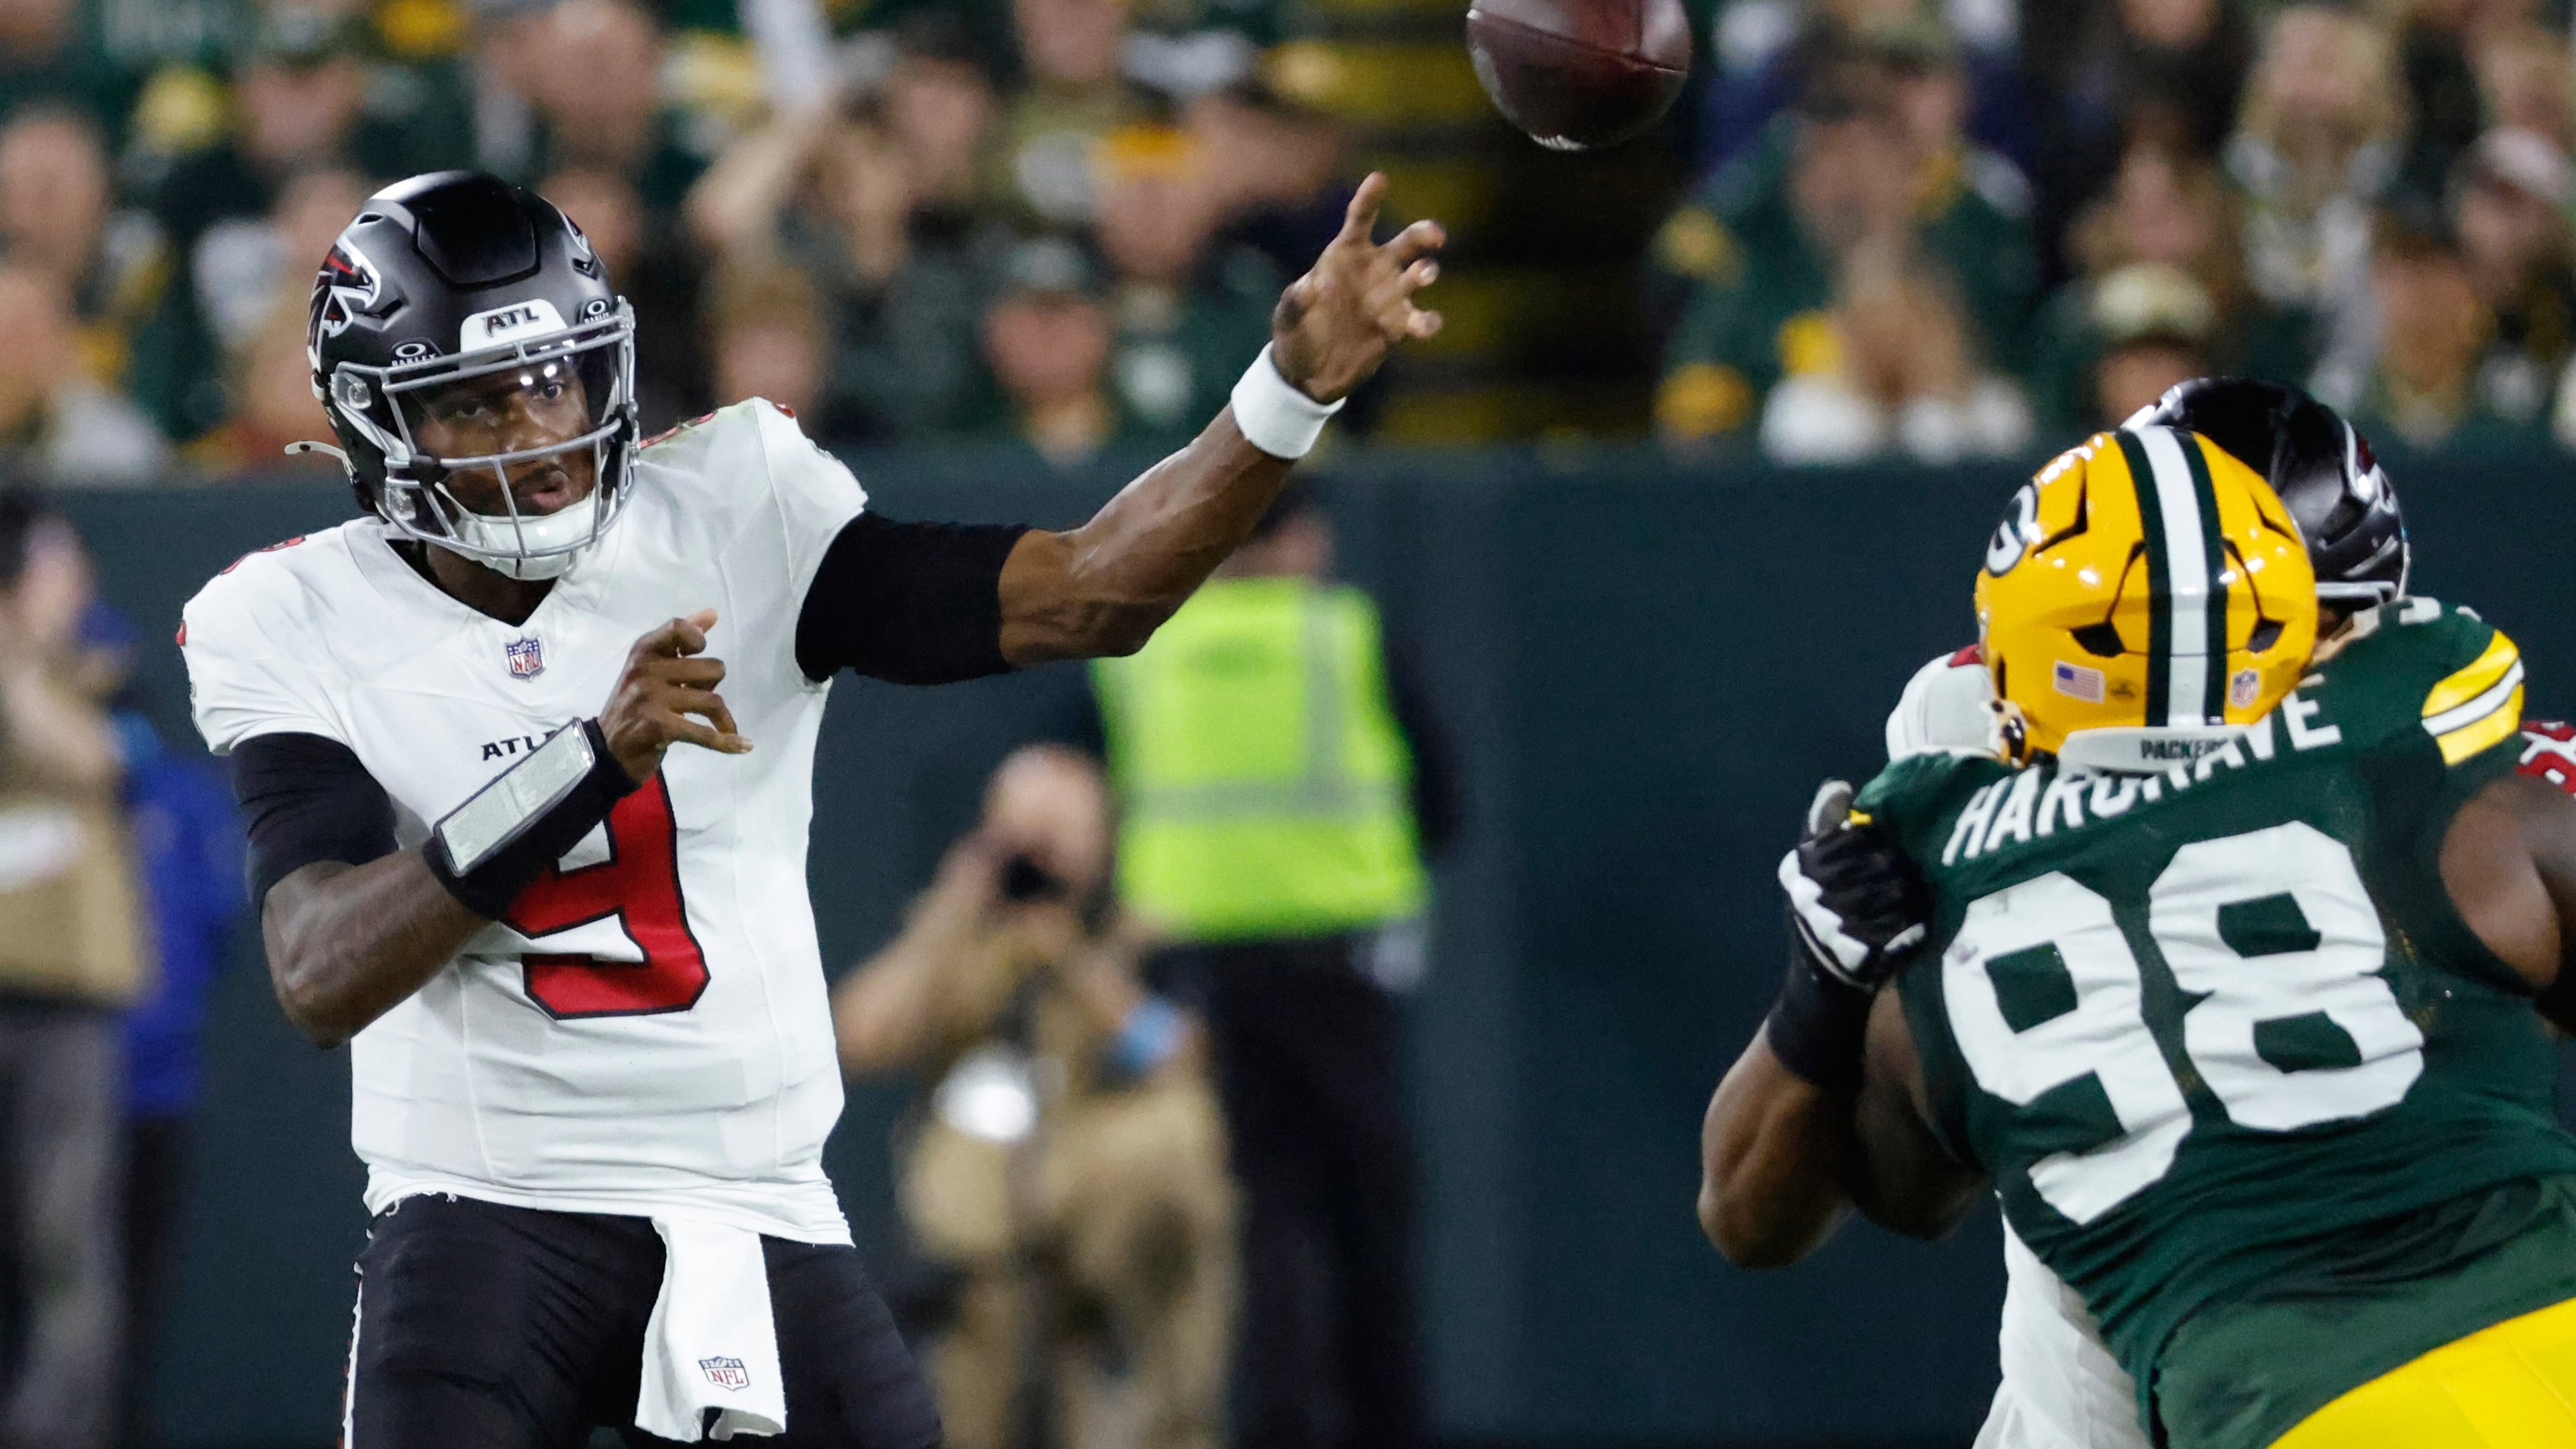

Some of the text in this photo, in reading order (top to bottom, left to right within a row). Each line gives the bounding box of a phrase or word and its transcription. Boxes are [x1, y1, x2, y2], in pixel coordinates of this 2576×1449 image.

[484, 307, 539, 336] ATL
[513, 652, 541, 672] NFL
[481, 730, 557, 761] ATL
[499, 760, 712, 1021] 9
[1941, 820, 2424, 1226] 98
[710, 1369, 744, 1385] NFL
